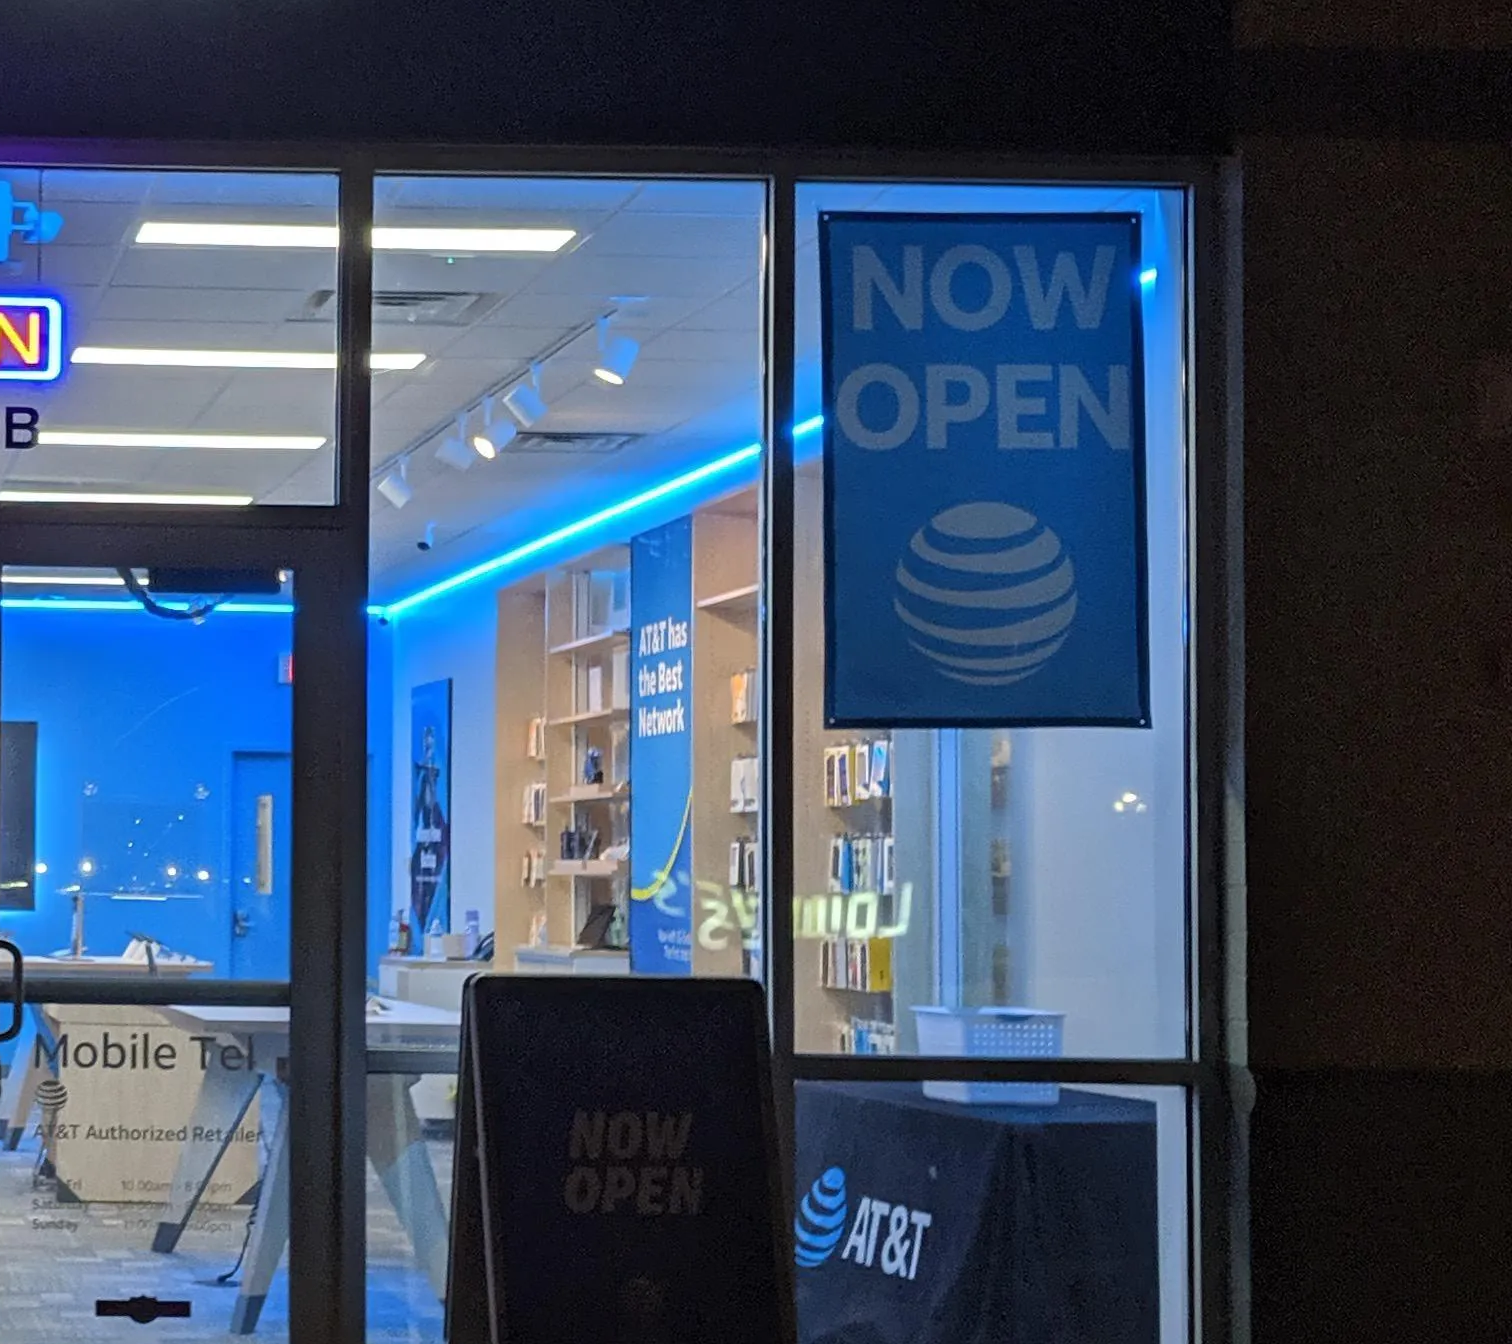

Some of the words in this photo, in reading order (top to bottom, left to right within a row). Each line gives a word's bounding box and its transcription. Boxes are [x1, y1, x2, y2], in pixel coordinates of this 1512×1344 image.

[852, 244, 1117, 332] NOW
[836, 362, 1131, 451] OPEN
[639, 619, 667, 658] AT&T
[667, 616, 688, 651] has
[639, 663, 657, 698] the
[657, 658, 684, 695] Best
[639, 697, 686, 738] Network
[33, 1031, 178, 1071] Mobile
[84, 1123, 188, 1143] Authorized
[569, 1107, 693, 1160] NOW
[563, 1165, 704, 1216] OPEN
[841, 1195, 933, 1281] AT&T
